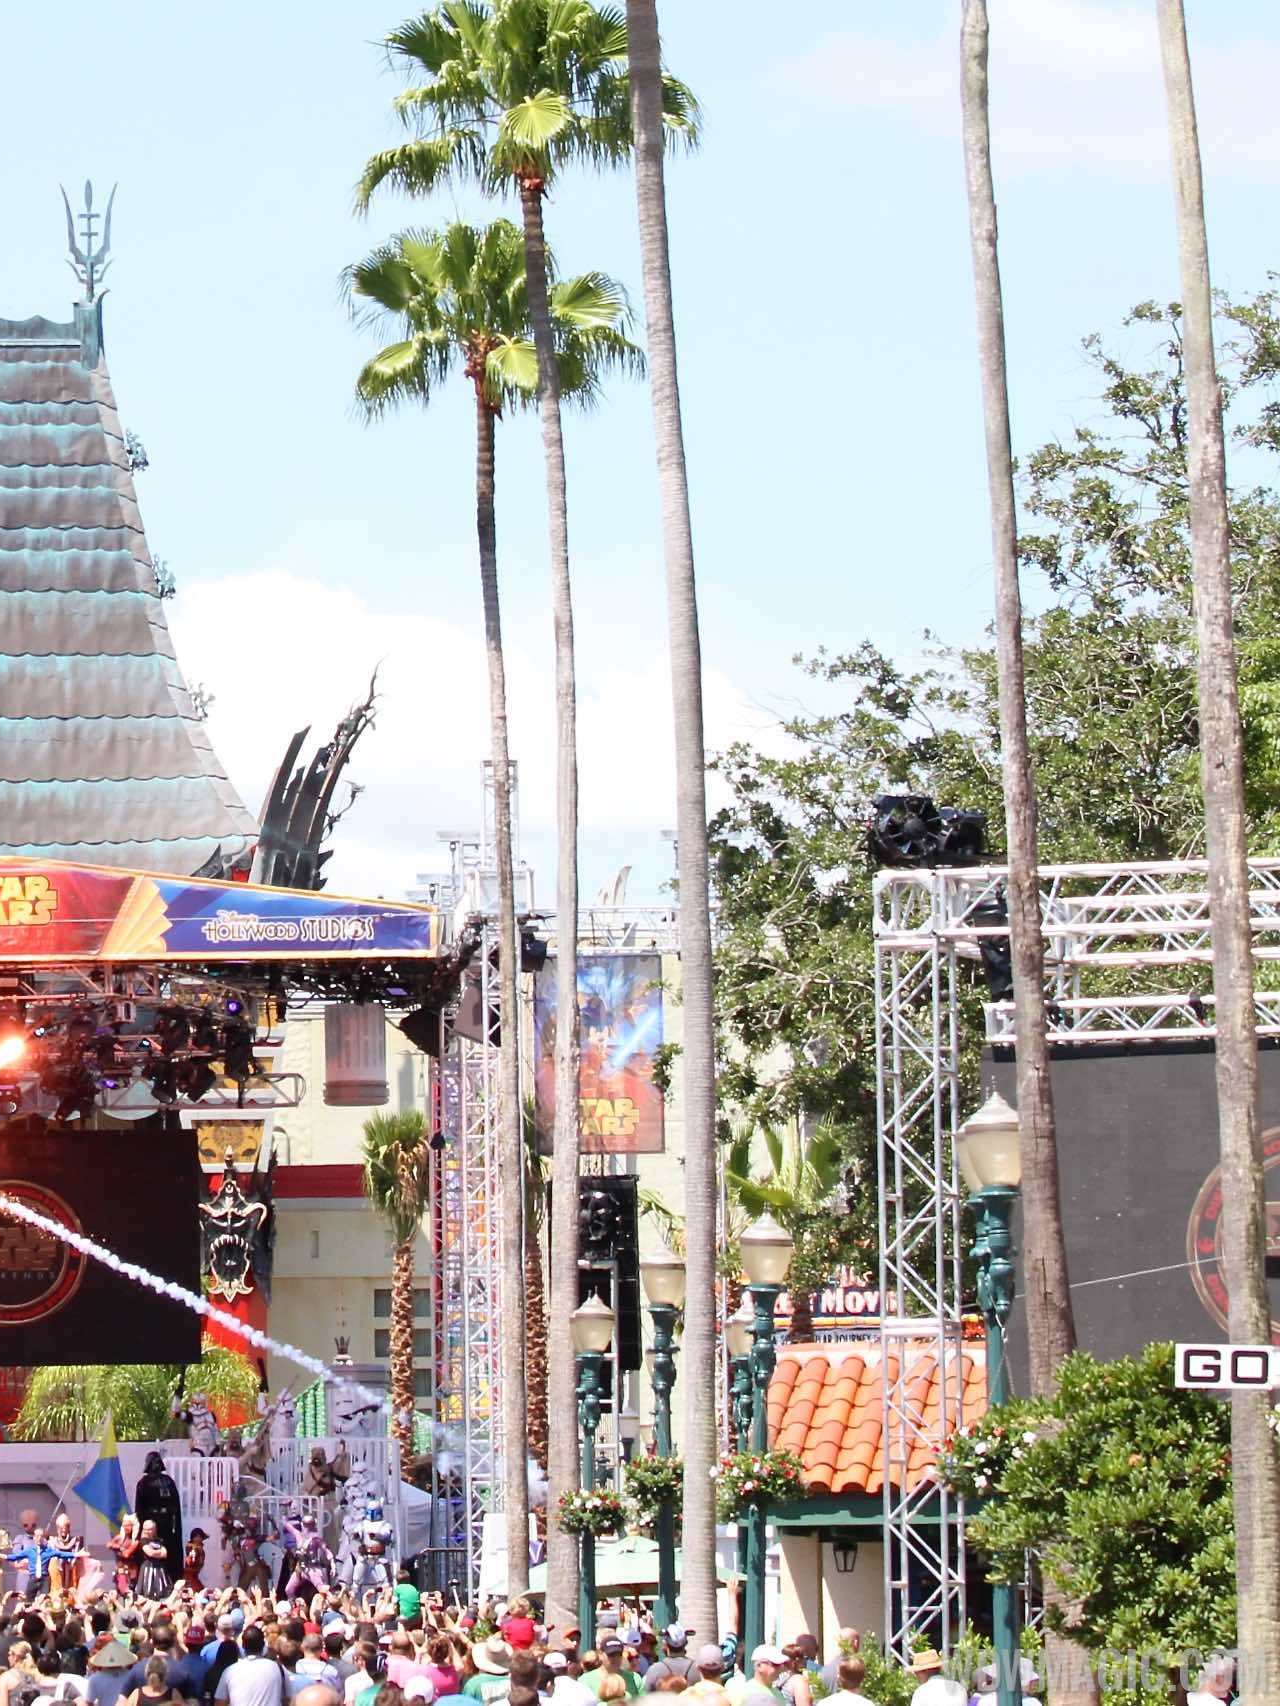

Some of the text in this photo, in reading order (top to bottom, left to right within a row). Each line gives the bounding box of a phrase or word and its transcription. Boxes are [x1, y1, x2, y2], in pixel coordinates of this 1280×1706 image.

[202, 917, 375, 943] HOLLYWOOD STUDIOS
[578, 1097, 640, 1117] TAR
[579, 1116, 640, 1136] ARS
[1182, 1349, 1269, 1384] GO
